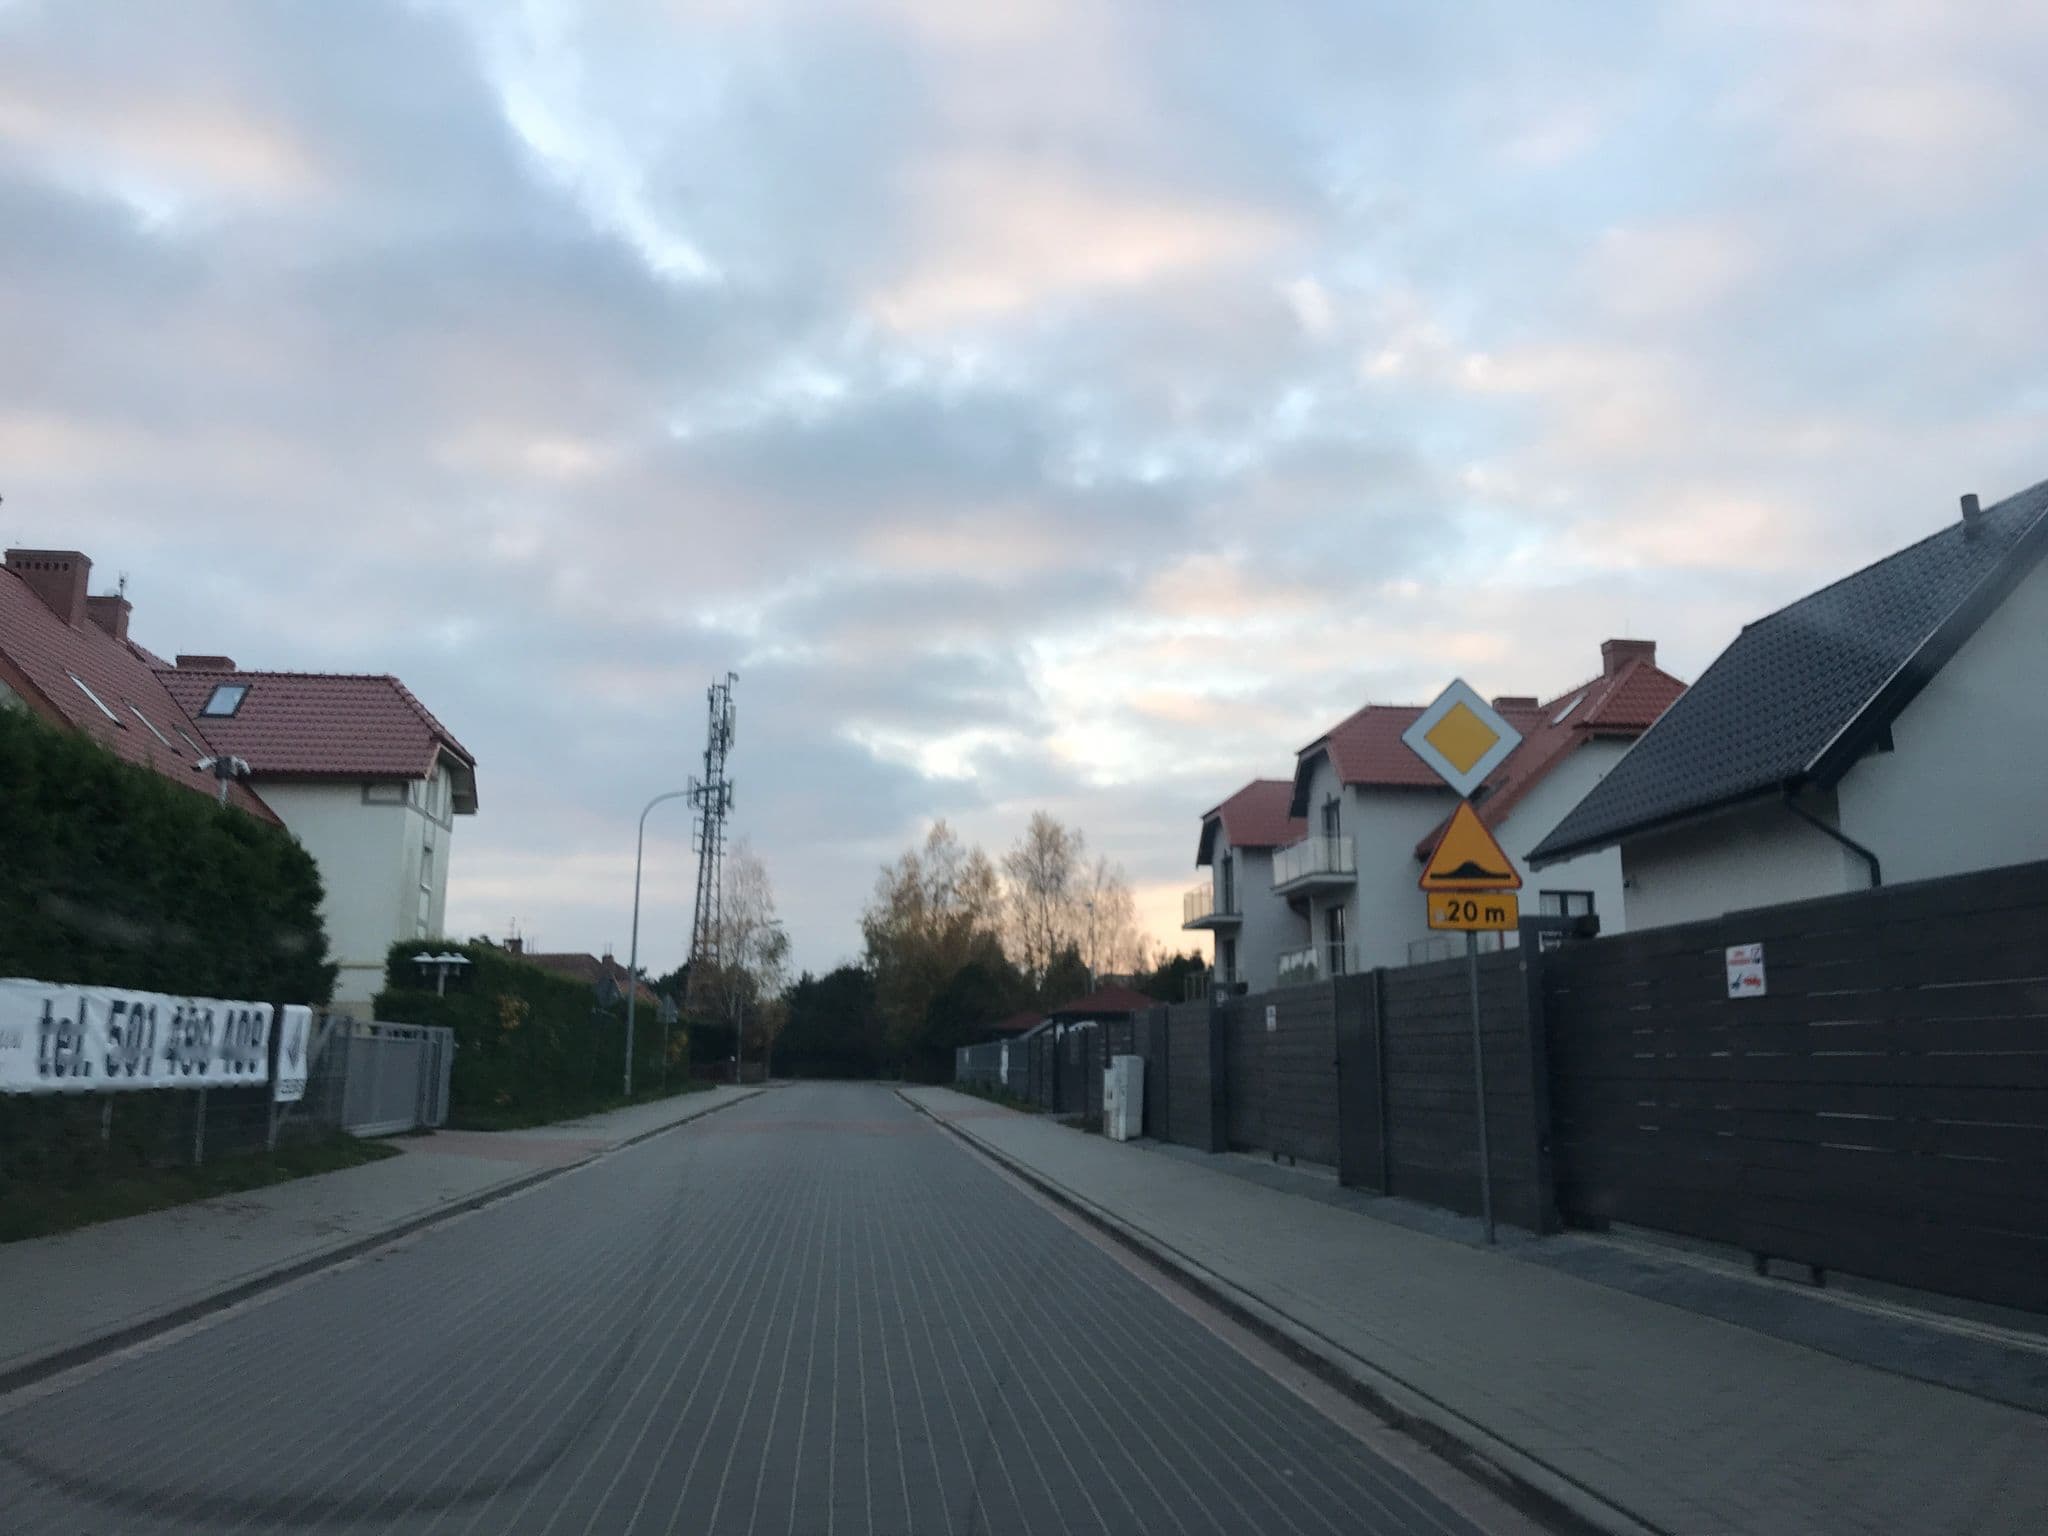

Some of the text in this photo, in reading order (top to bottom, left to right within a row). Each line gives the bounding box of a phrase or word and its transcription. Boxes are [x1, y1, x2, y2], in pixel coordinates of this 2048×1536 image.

[1447, 900, 1505, 922] 20 m
[39, 997, 92, 1077] tel.
[105, 999, 158, 1077] 501
